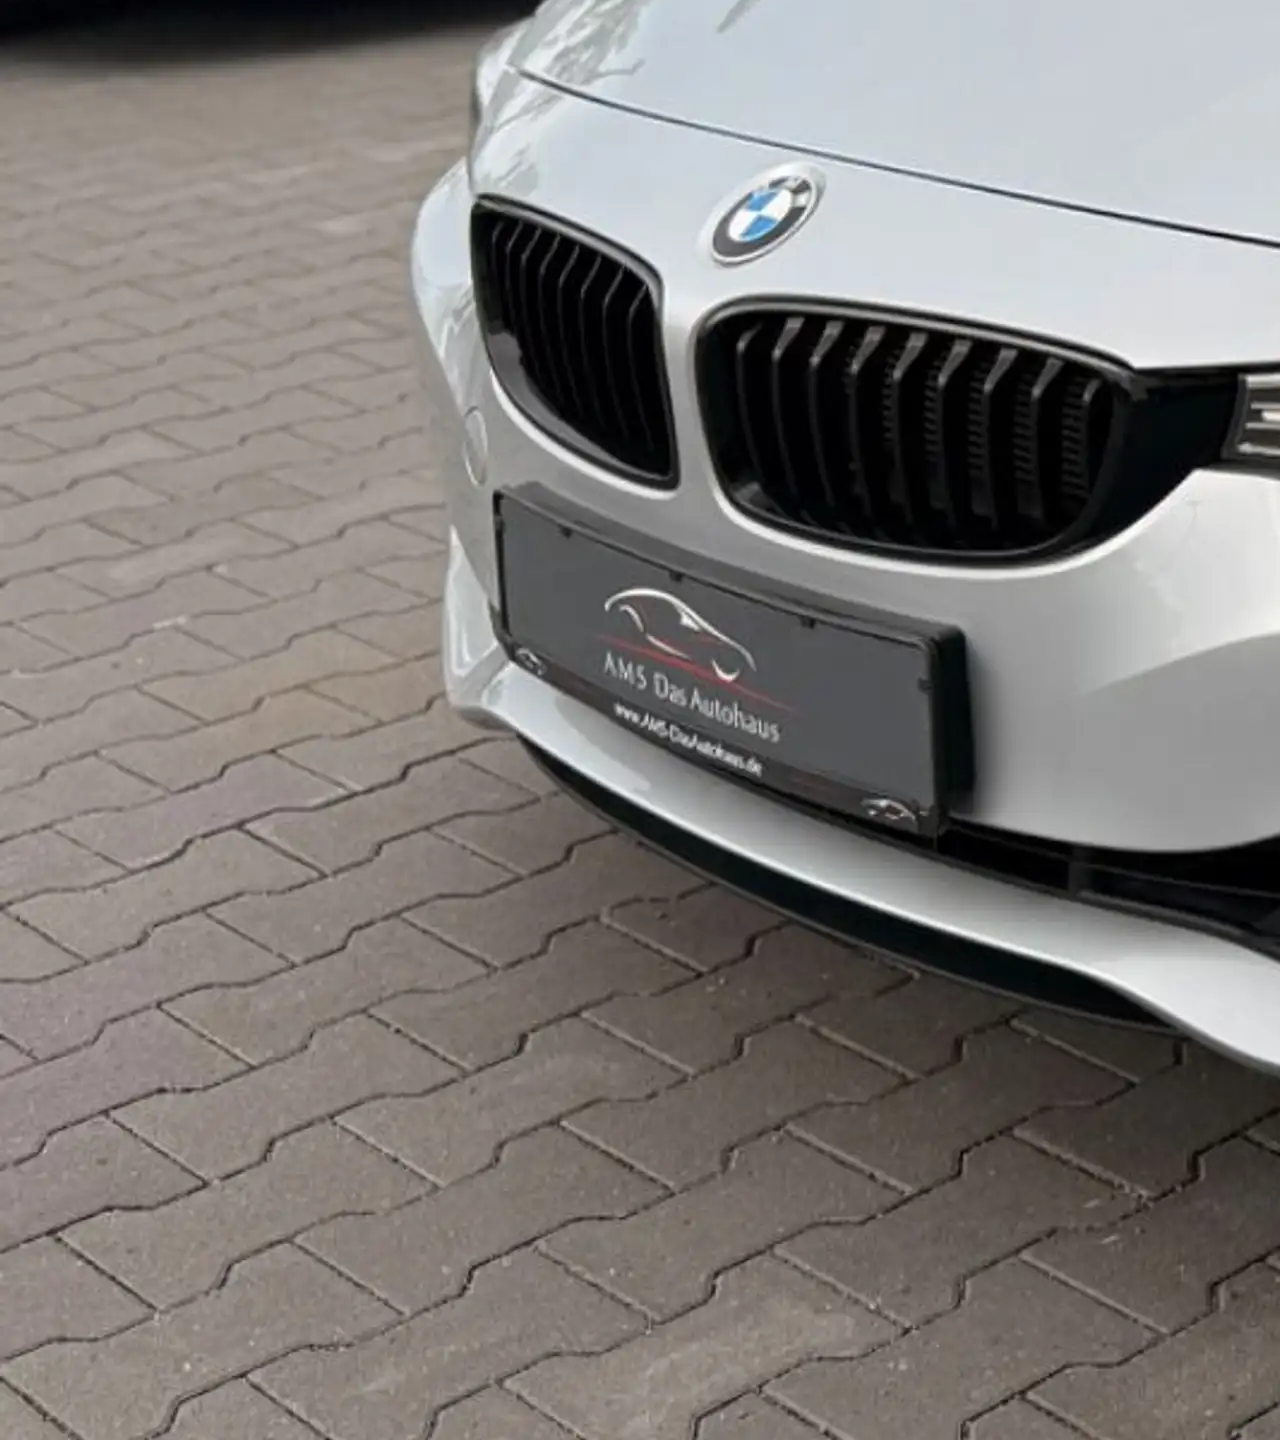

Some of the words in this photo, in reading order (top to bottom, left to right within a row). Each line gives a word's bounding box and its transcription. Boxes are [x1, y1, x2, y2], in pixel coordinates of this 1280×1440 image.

[604, 650, 648, 691] AMS
[653, 671, 687, 707] Das
[689, 685, 781, 744] Autohaus
